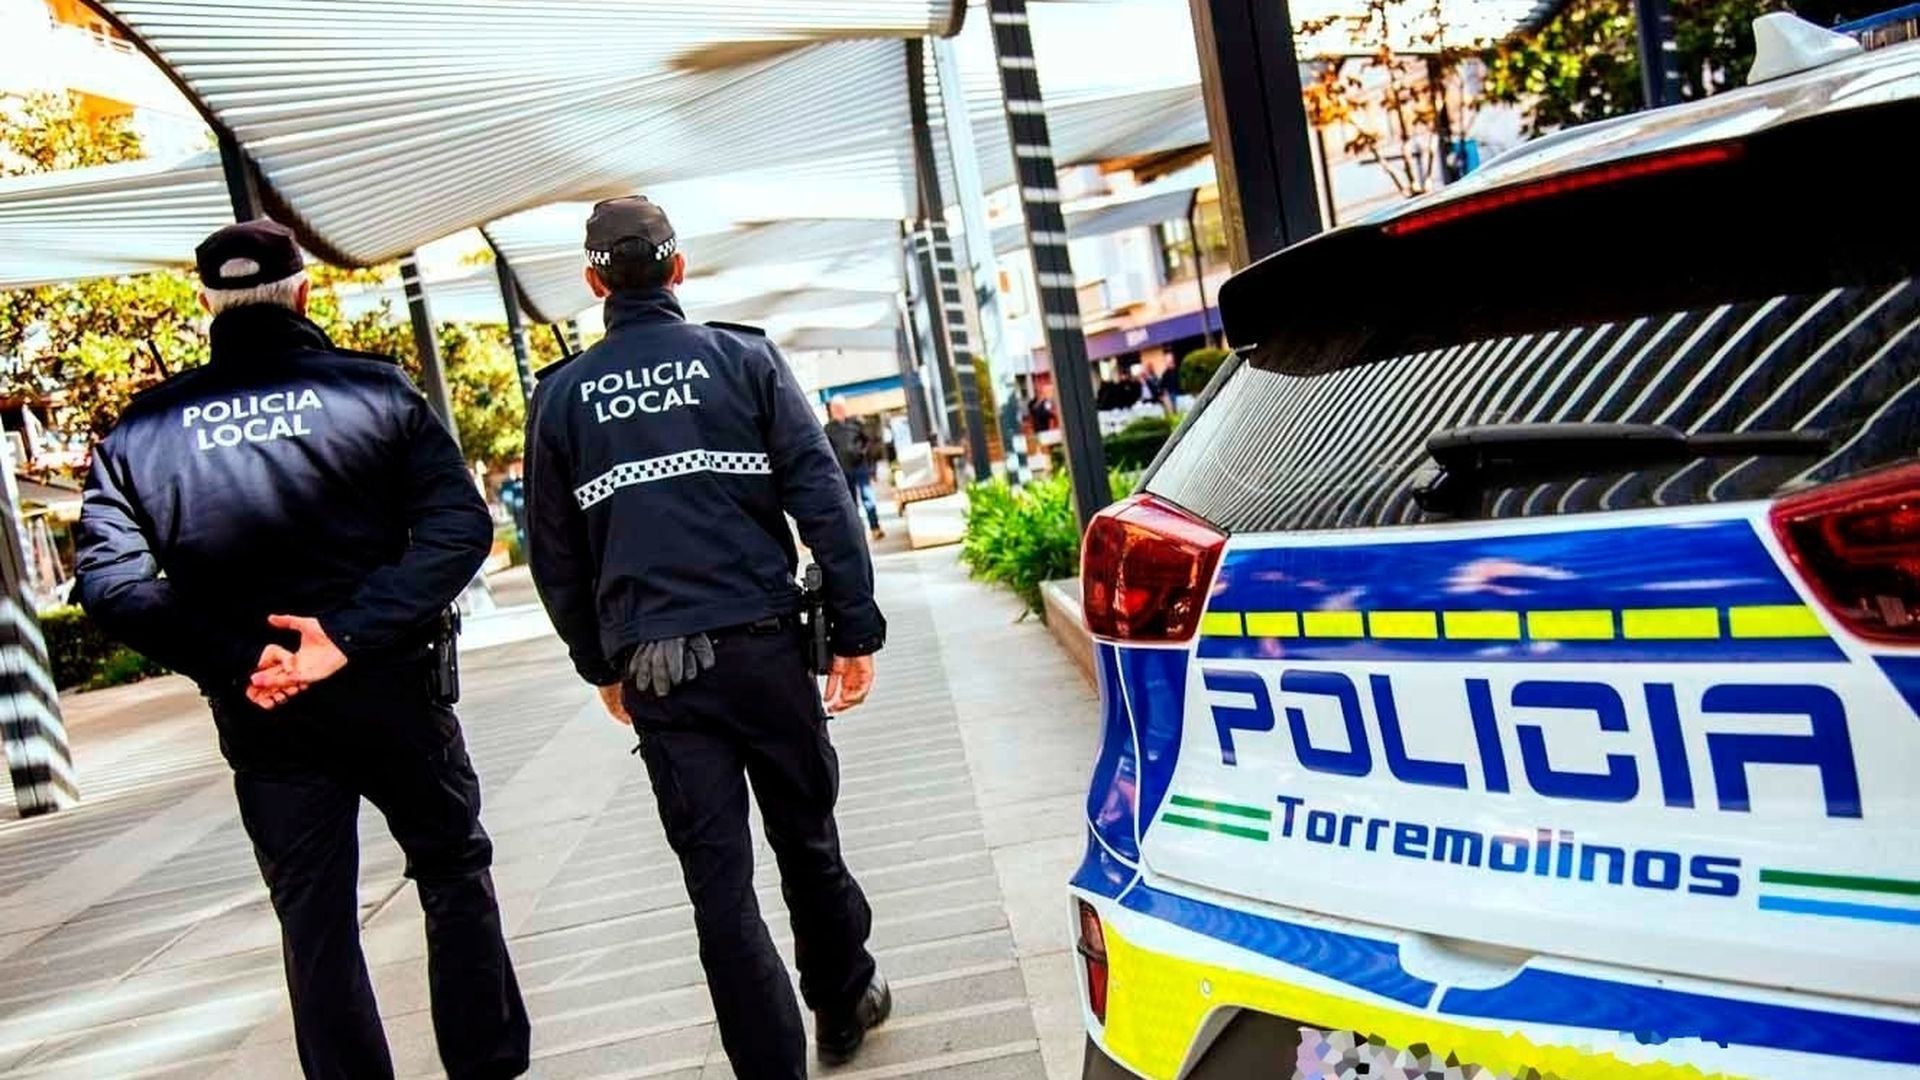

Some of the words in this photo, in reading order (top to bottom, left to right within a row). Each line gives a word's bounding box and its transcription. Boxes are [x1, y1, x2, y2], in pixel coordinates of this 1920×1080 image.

[580, 359, 710, 402] POLICIA
[182, 389, 323, 427] POLICIA
[595, 383, 700, 424] LOCAL
[196, 414, 312, 450] LOCAL
[1202, 667, 1863, 819] POLICIA
[1276, 795, 1742, 898] Torremolinos
